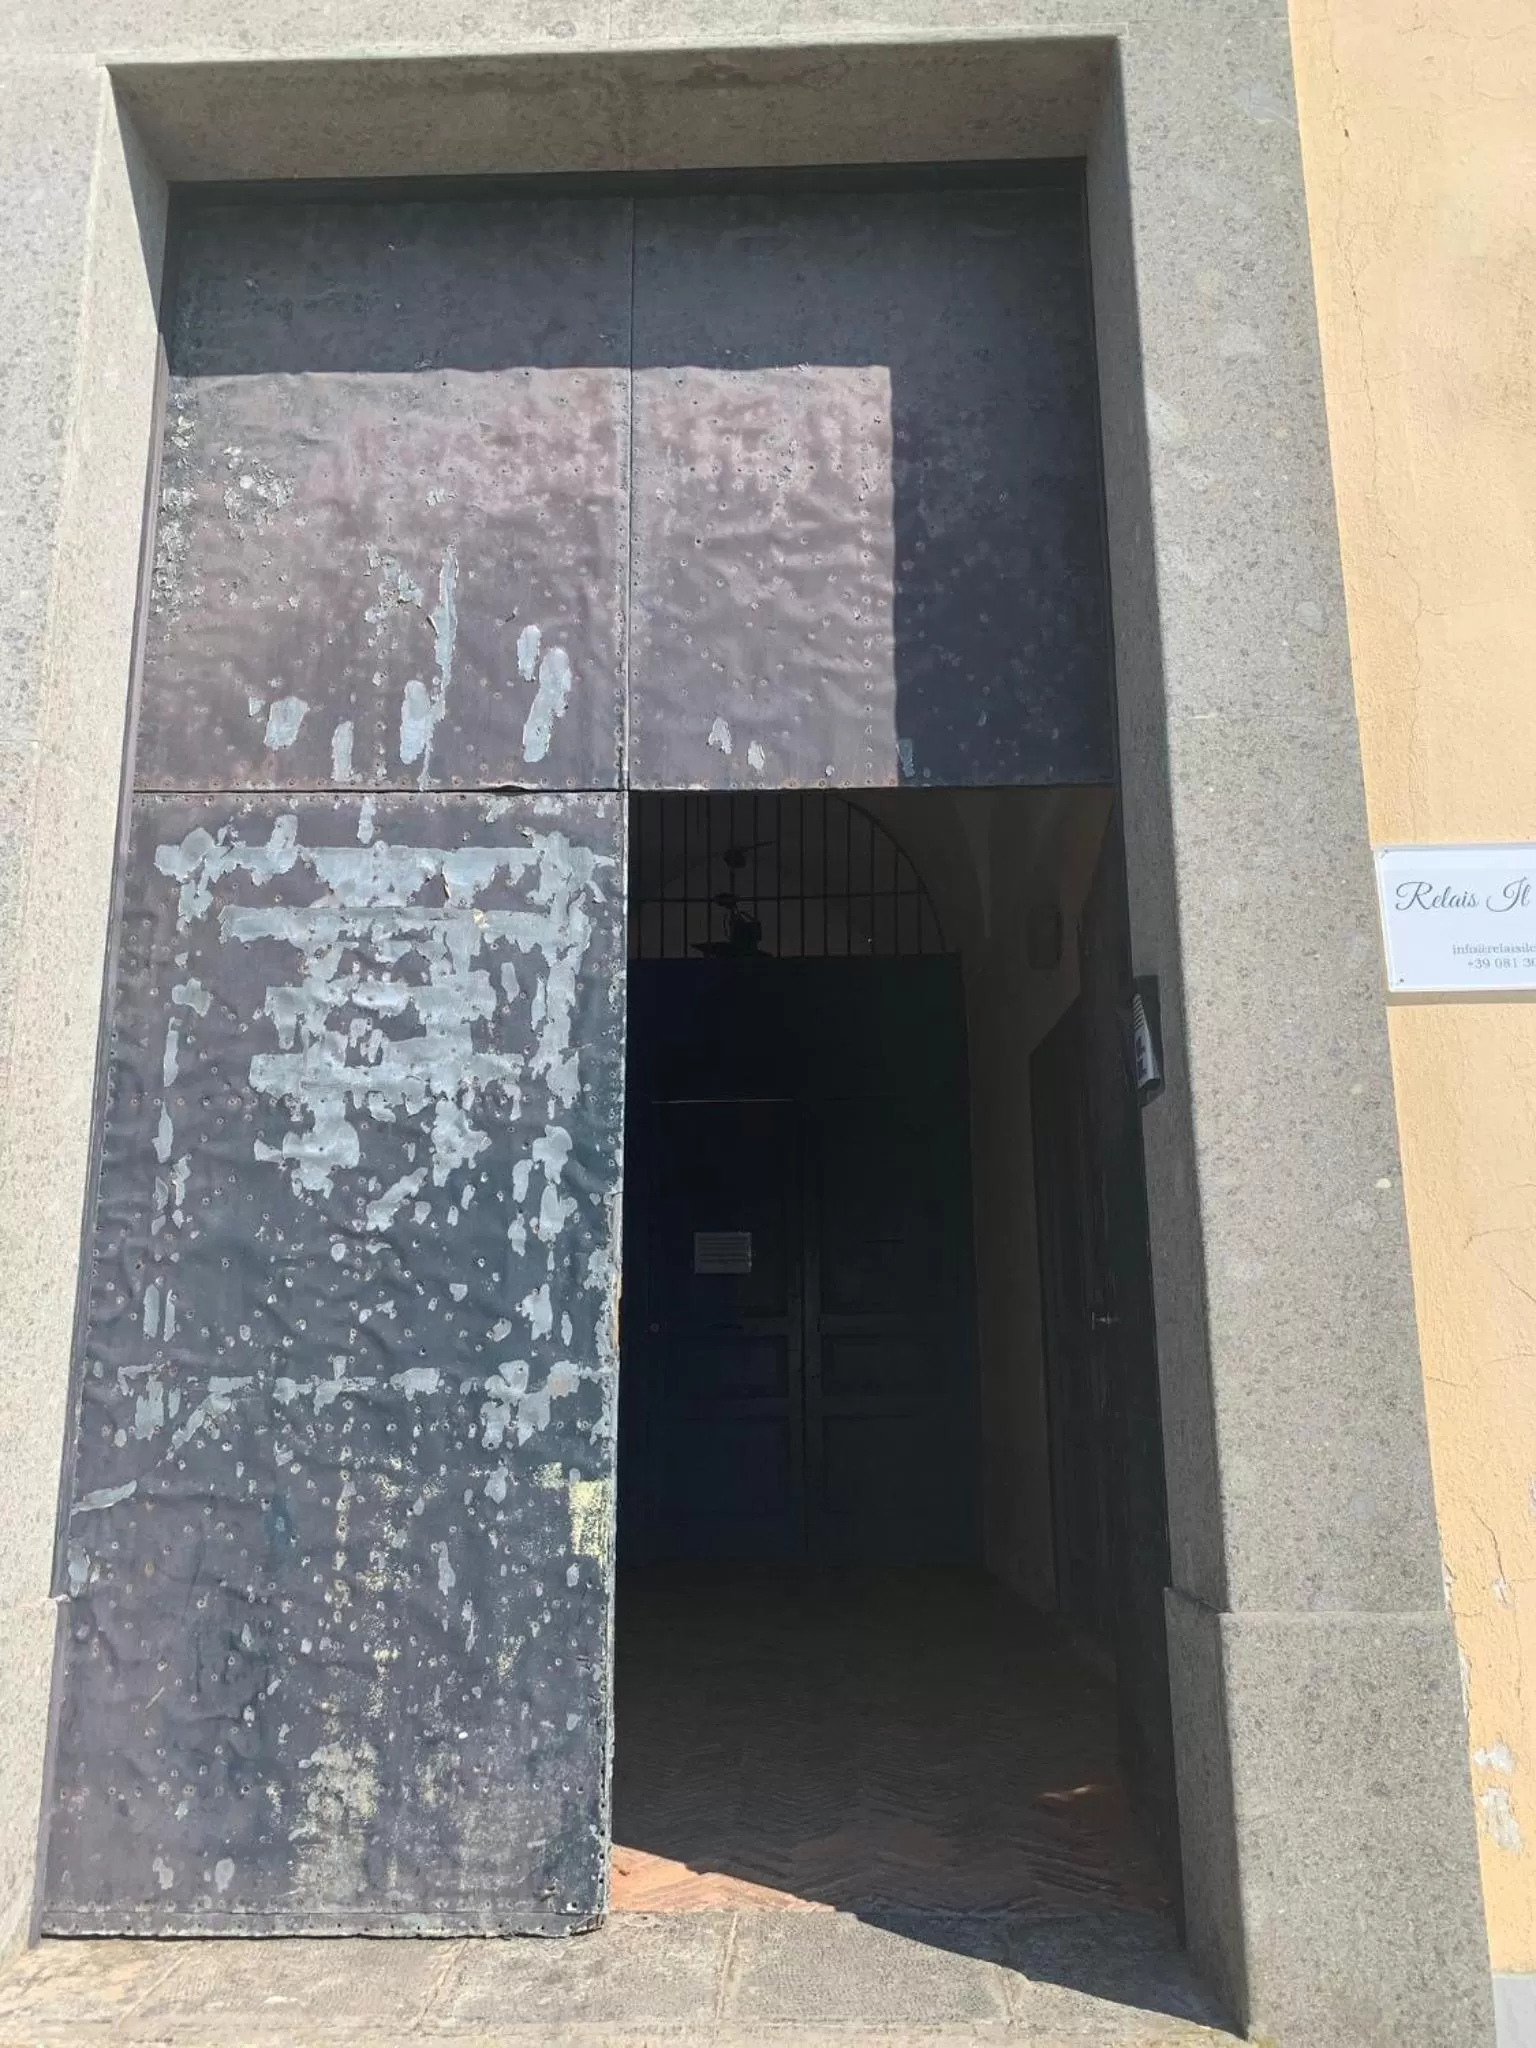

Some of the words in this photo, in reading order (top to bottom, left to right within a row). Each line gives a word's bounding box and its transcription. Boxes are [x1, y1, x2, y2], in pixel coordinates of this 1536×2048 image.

[1395, 881, 1478, 911] Relais
[1486, 876, 1532, 912] Il
[1468, 957, 1490, 969] +39
[1494, 957, 1517, 968] 081
